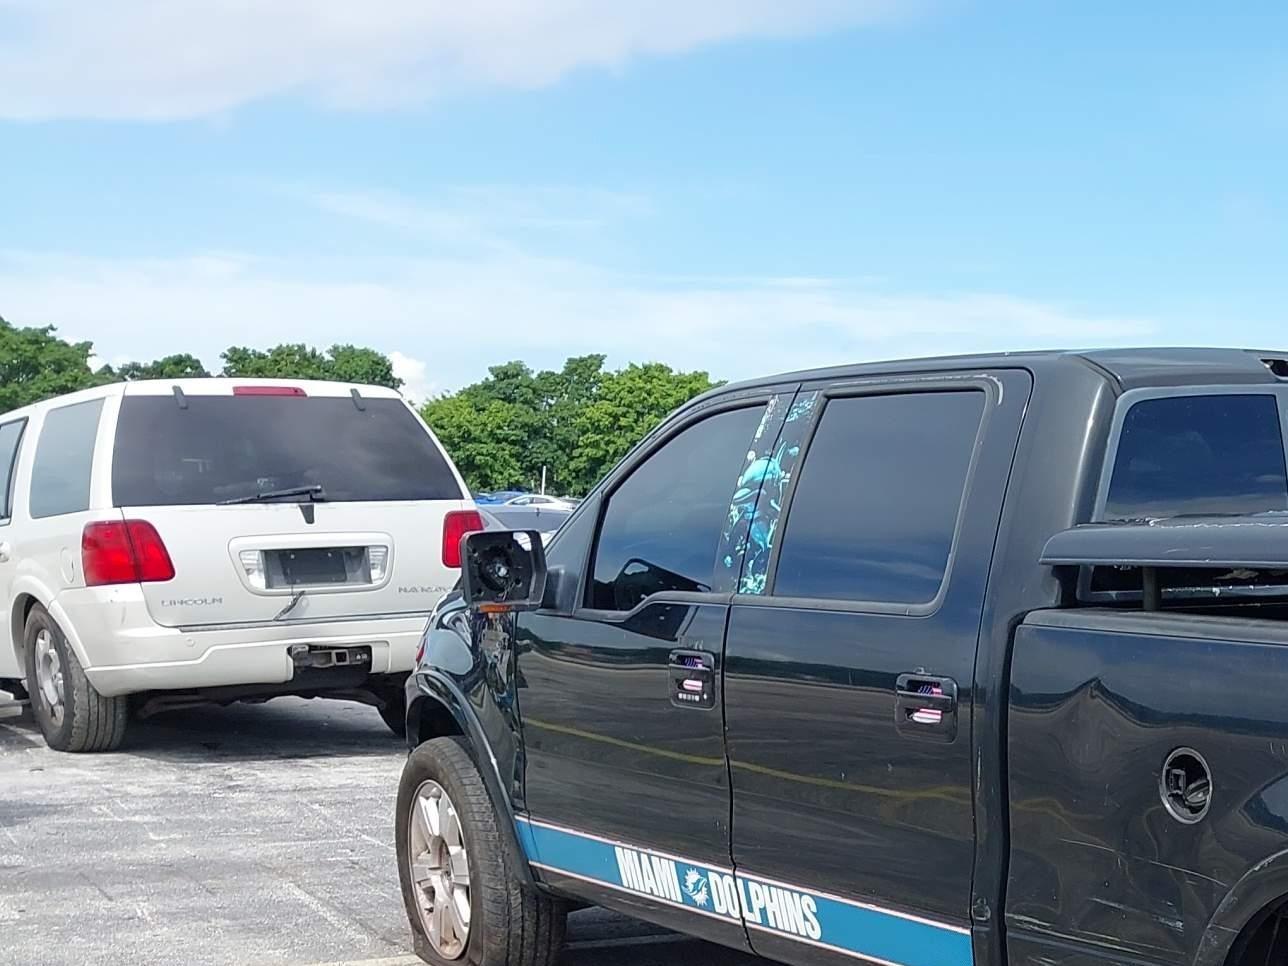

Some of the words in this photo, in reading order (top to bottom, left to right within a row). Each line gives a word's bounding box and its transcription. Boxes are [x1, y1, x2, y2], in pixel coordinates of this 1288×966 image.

[161, 597, 223, 607] LINCOLN
[614, 846, 683, 903] MIAMI
[707, 871, 822, 941] DOLPHINS
